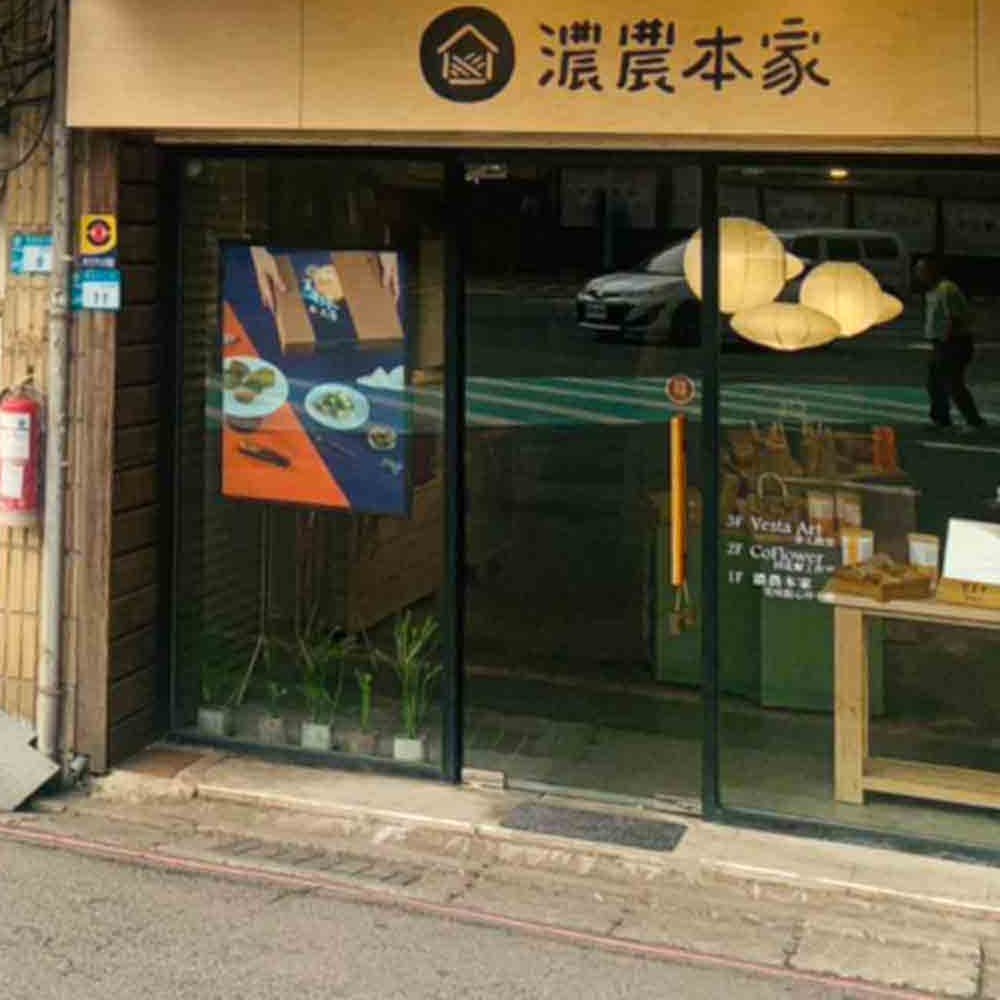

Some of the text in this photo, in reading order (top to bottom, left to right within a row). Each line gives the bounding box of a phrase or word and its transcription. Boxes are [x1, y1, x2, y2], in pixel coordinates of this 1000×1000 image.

[538, 16, 831, 97] 濃農本家
[751, 516, 793, 533] Vesta
[796, 520, 822, 537] Art
